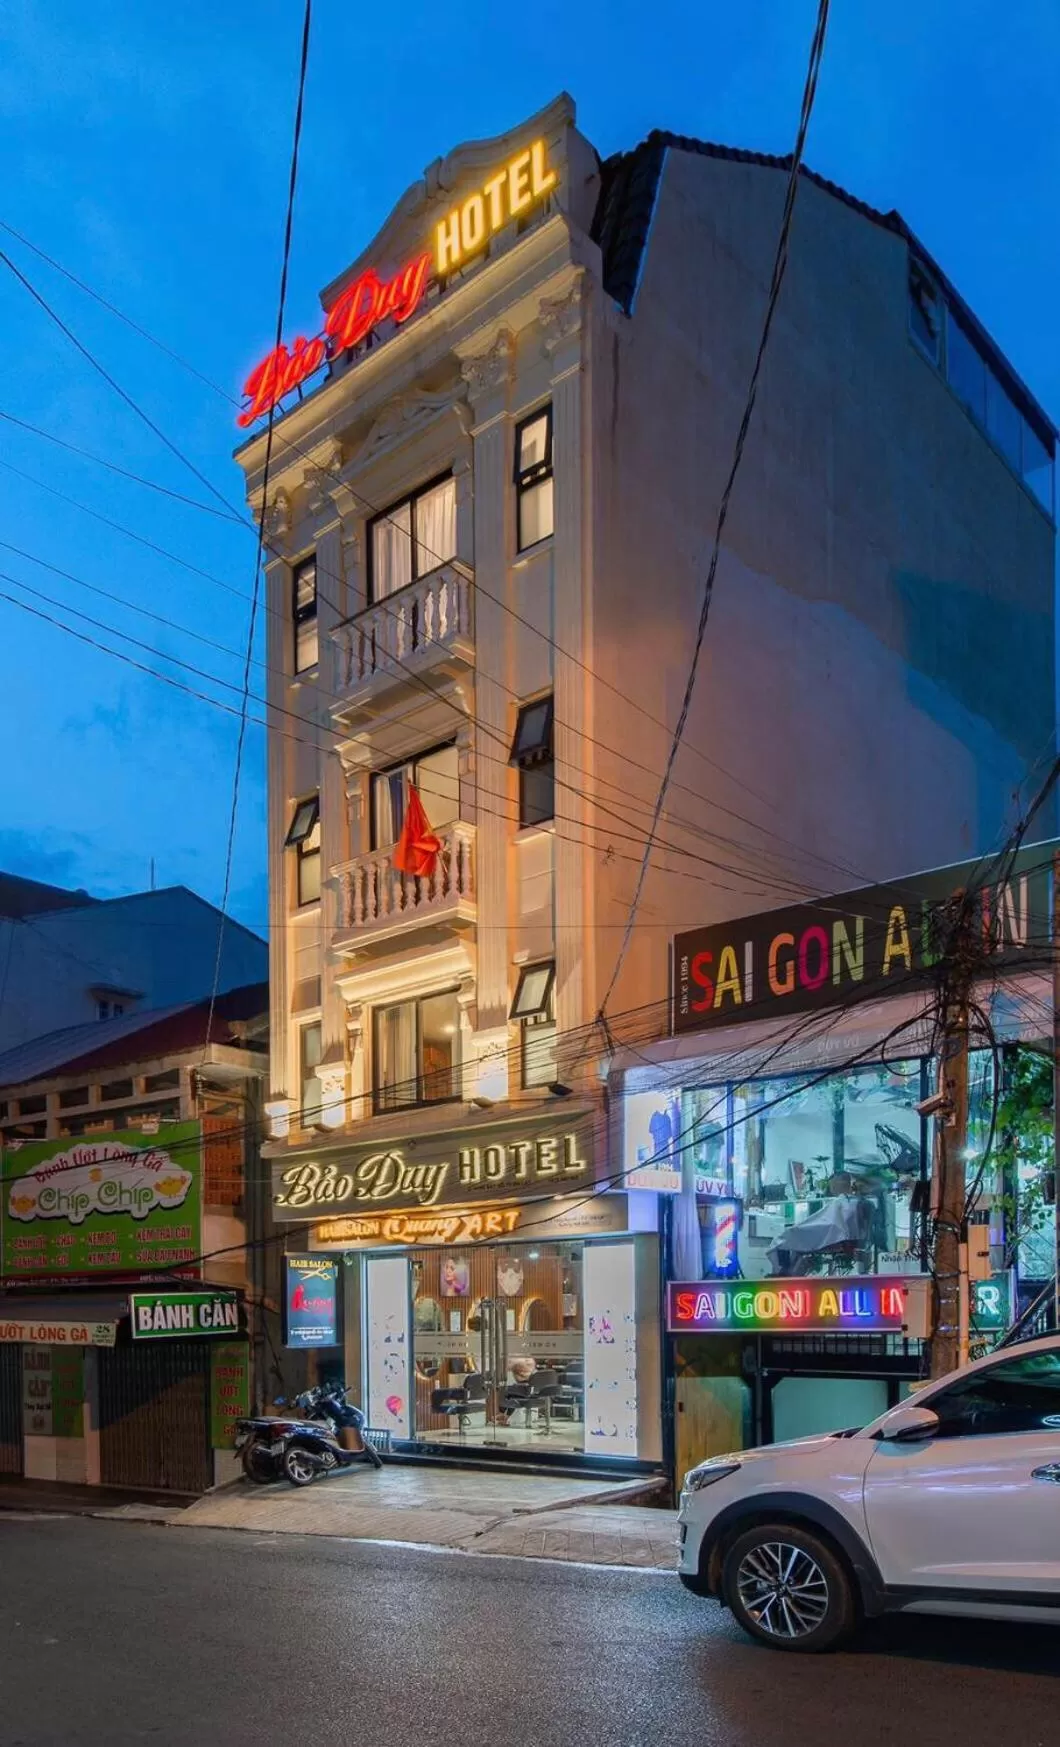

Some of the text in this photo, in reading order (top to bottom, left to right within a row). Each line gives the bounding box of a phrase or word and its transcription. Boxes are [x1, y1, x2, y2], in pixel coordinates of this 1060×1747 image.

[436, 139, 556, 274] HOTEL
[691, 915, 864, 1013] SAIGON
[275, 1133, 587, 1207] Bảo Duy HOTEL
[138, 1298, 239, 1331] BÁNH CĂN
[677, 1289, 810, 1319] SAIGON
[818, 1289, 872, 1317] ALL
[30, 1323, 66, 1341] LÒNG
[71, 1326, 88, 1342] GÀ
